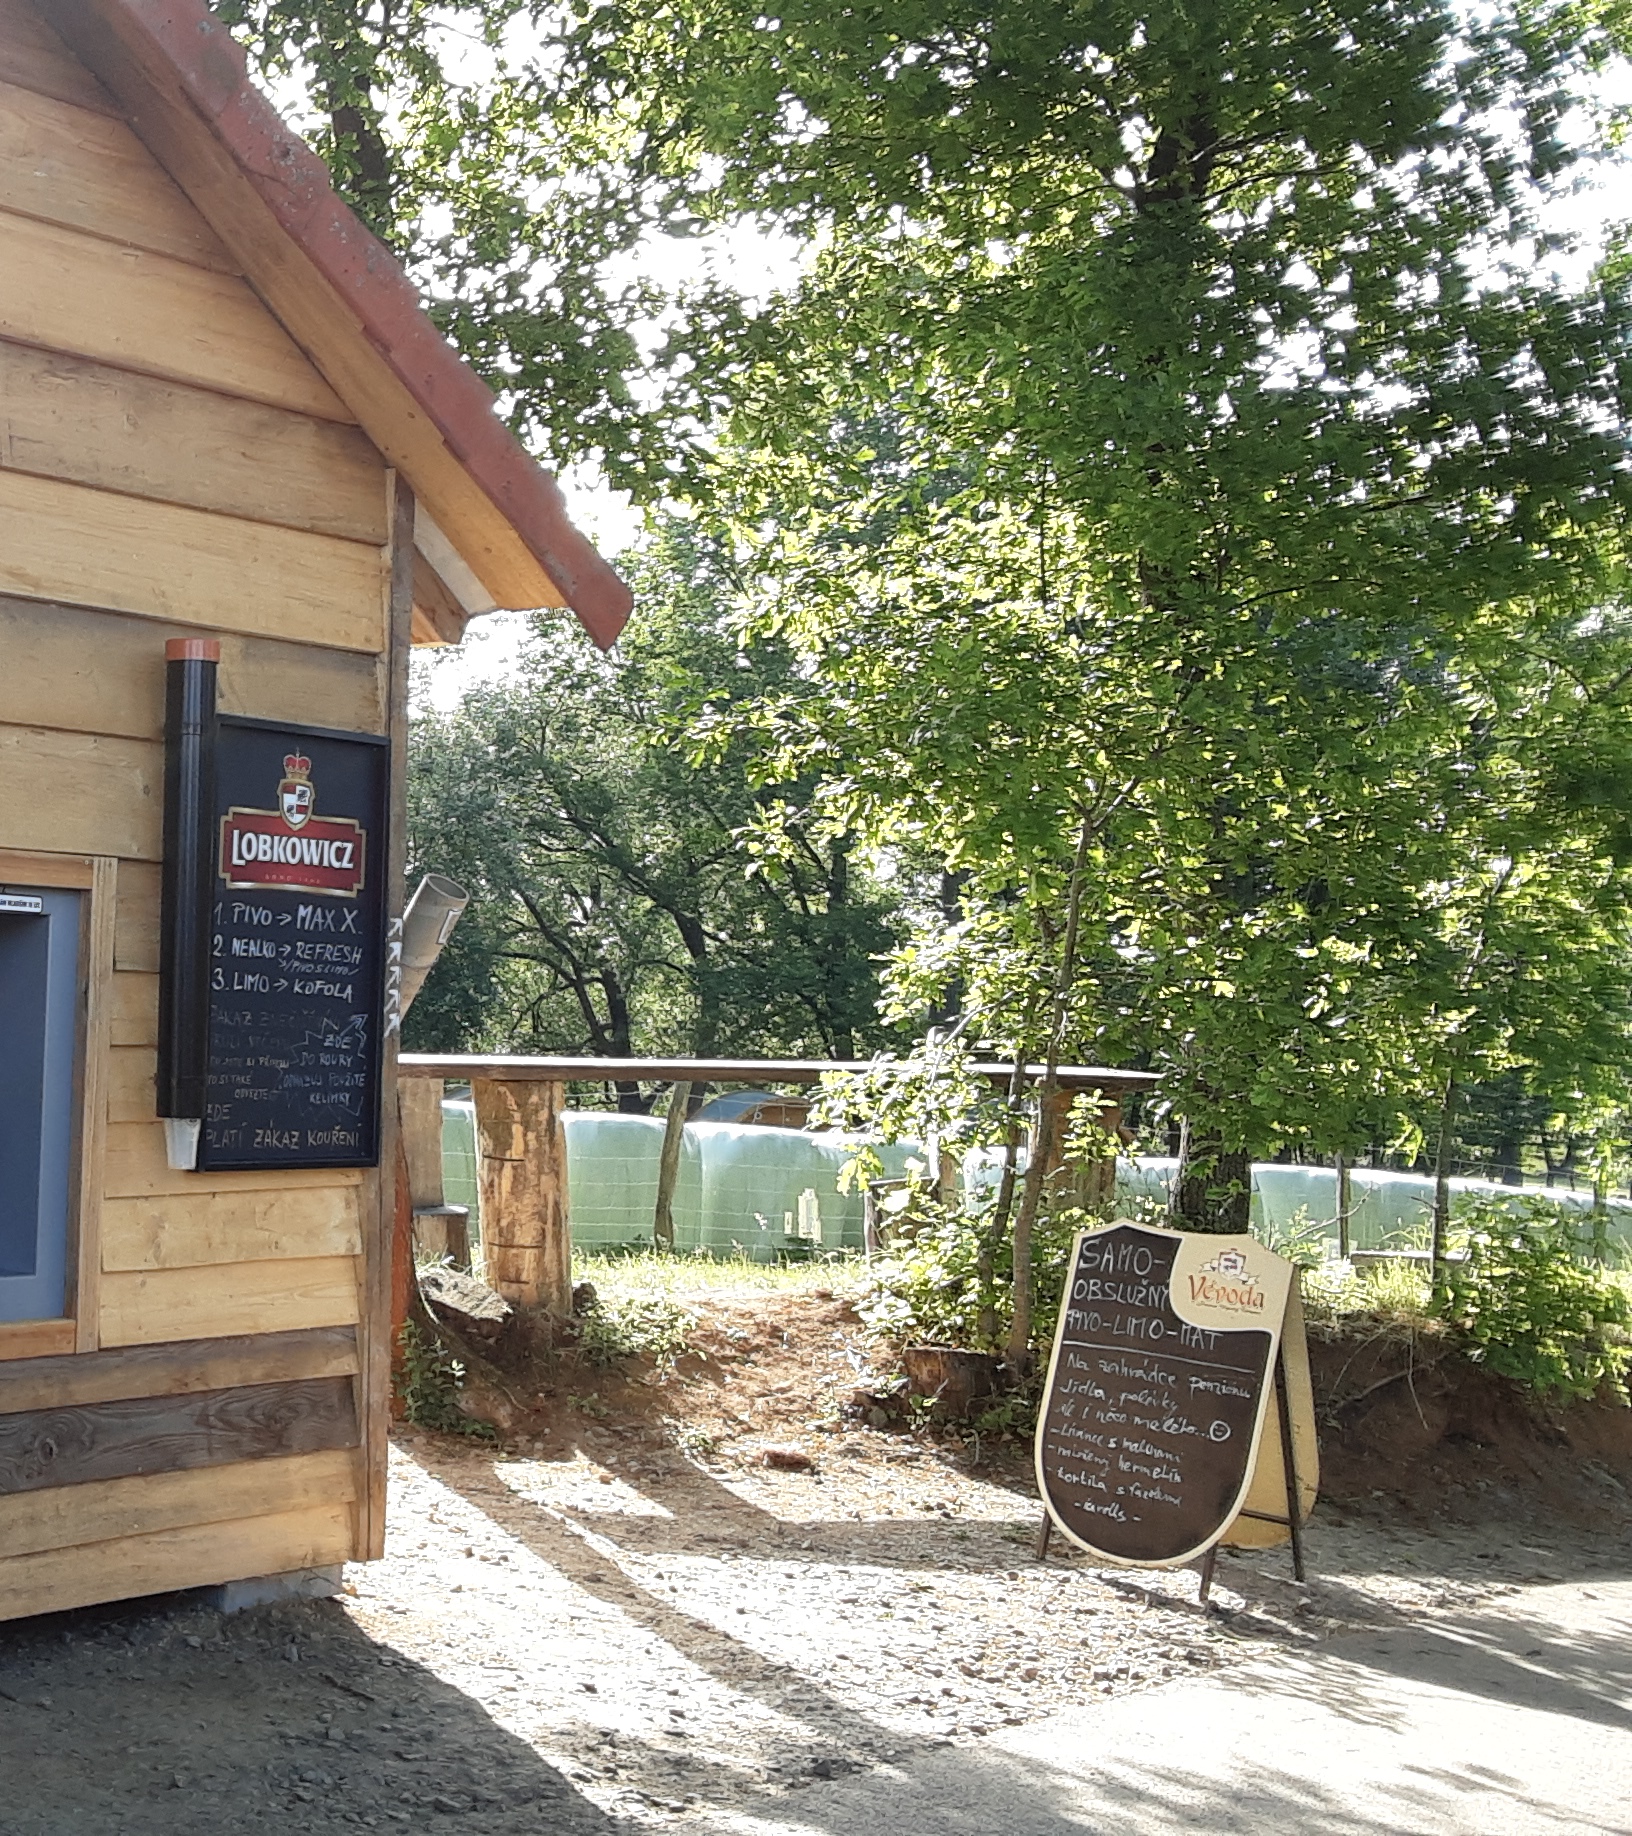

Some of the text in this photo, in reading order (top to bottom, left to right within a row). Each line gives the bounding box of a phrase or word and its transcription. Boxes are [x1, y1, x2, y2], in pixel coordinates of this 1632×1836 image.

[231, 829, 355, 870] LOBKOWICZ
[214, 902, 228, 925] 1.
[231, 902, 273, 926] PIVO
[212, 934, 362, 965] 2. NEALKO REFRESH
[211, 968, 353, 1003] 3. LIMO KOFOLA
[323, 1034, 353, 1049] ZDE
[300, 1051, 353, 1067] DO ROURY
[253, 1120, 300, 1149] ZÁKAZ
[1078, 1238, 1166, 1276] SAMO-
[1073, 1278, 1170, 1311] OBSLUŽNÝ
[1066, 1352, 1090, 1370] Na
[1107, 1437, 1118, 1448] s
[1116, 1486, 1125, 1495] s
